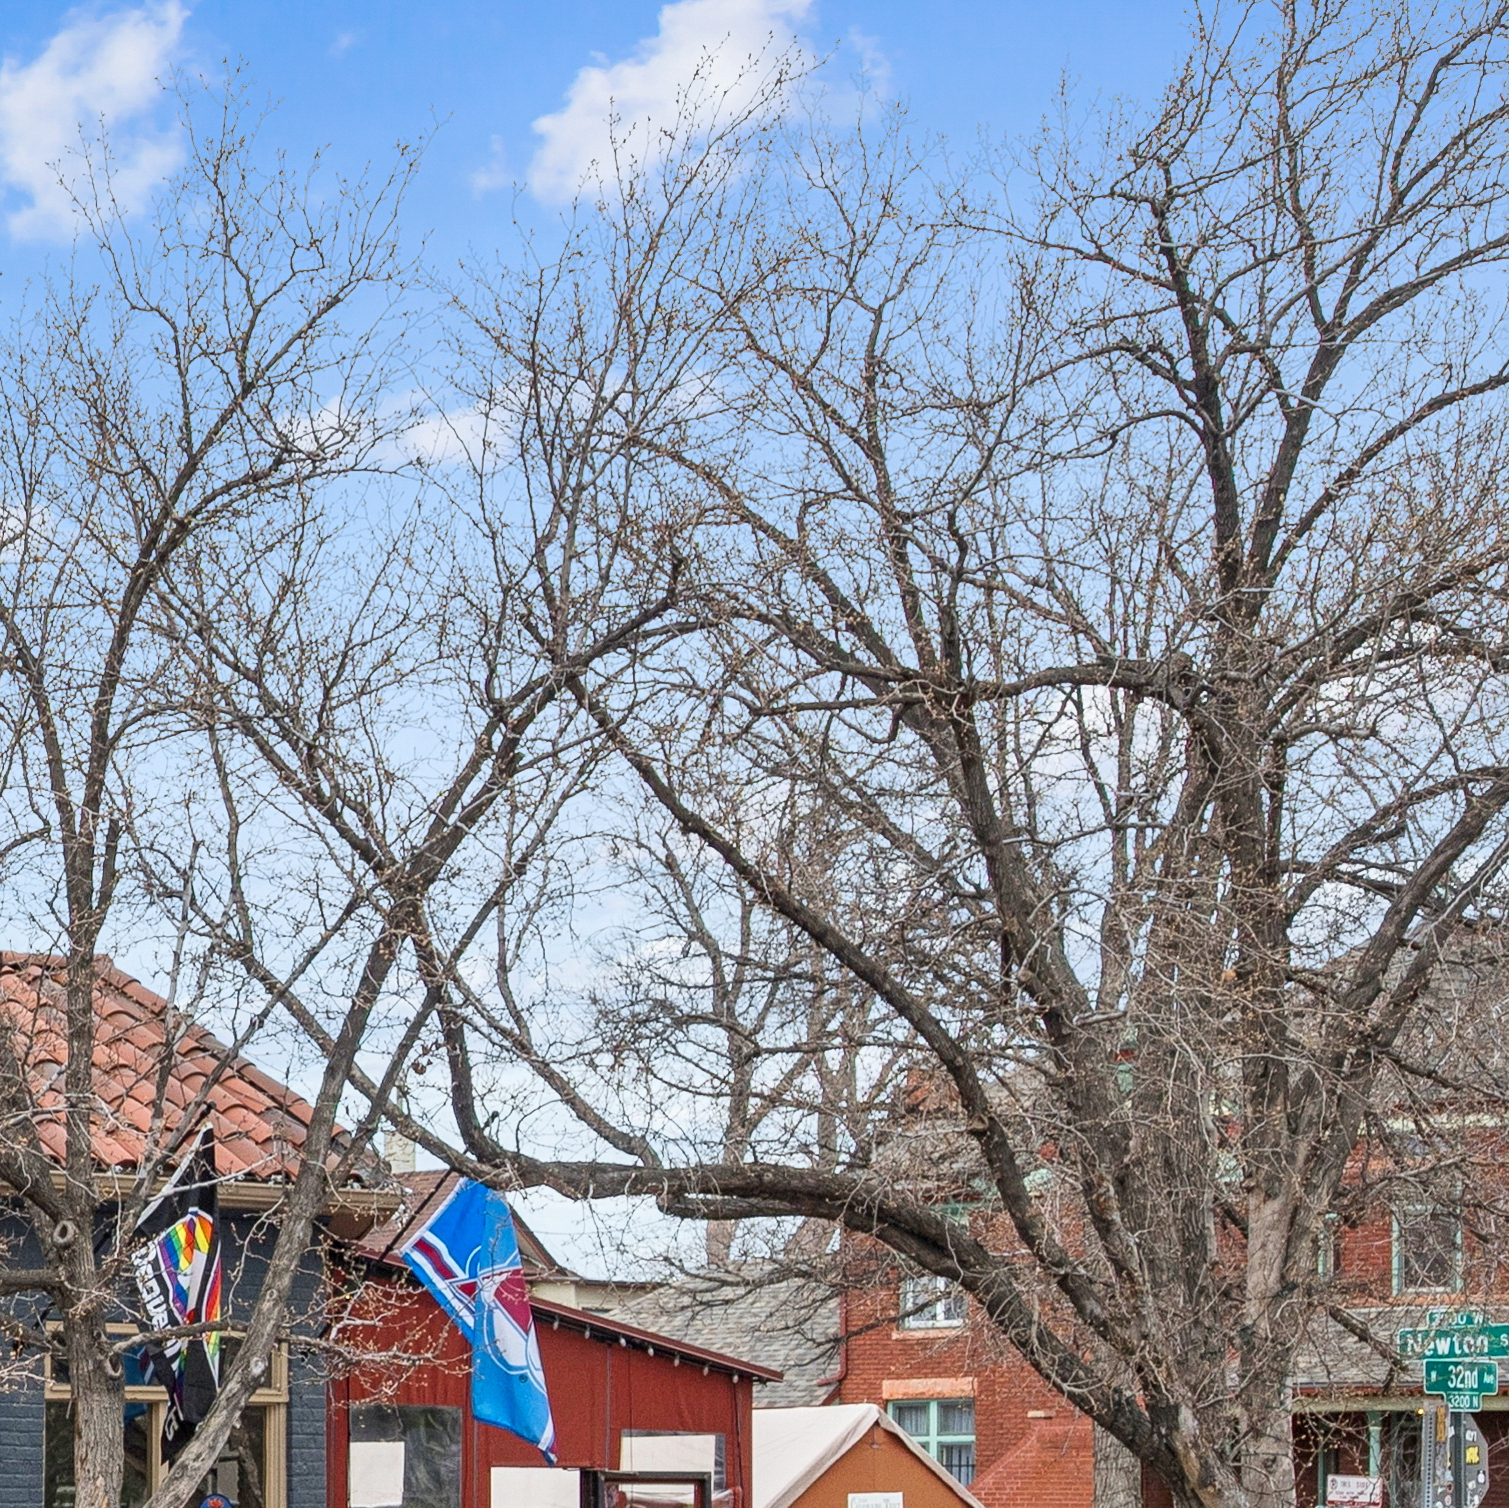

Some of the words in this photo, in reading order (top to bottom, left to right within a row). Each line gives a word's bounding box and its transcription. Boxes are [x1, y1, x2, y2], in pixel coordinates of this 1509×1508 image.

[1406, 1332, 1489, 1356] Newton
[1500, 1333, 1509, 1347] S
[1447, 1365, 1479, 1389] 32nd
[1483, 1372, 1495, 1384] Ave
[1449, 1395, 1471, 1408] 3200
[1472, 1395, 1479, 1408] N
